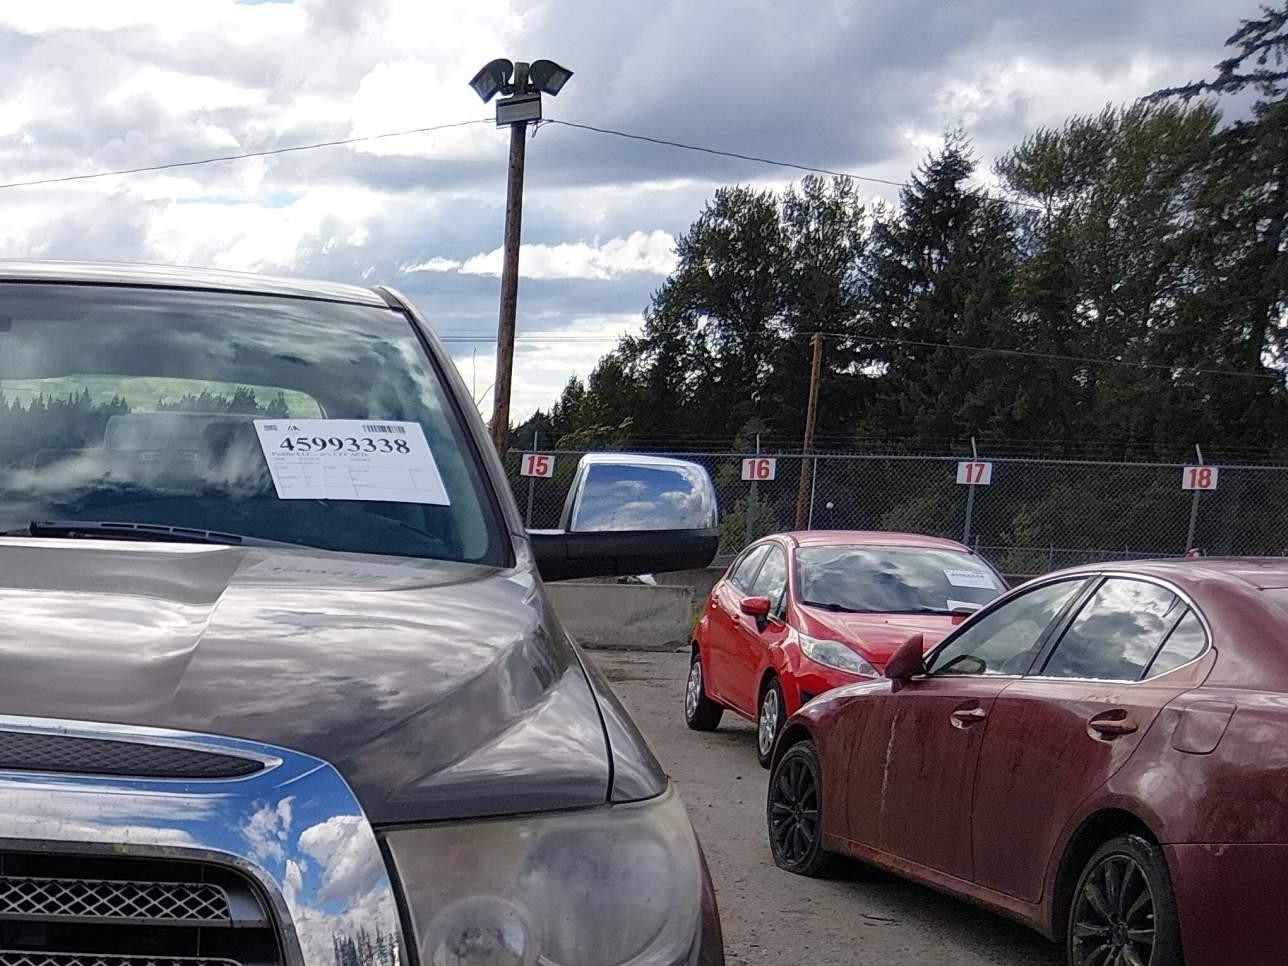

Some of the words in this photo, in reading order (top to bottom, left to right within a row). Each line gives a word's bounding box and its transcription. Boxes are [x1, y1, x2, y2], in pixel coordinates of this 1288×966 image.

[279, 436, 410, 454] 45993338
[527, 455, 549, 476] 15
[748, 459, 770, 479] 16
[965, 463, 986, 483] 17
[1189, 468, 1212, 489] 18
